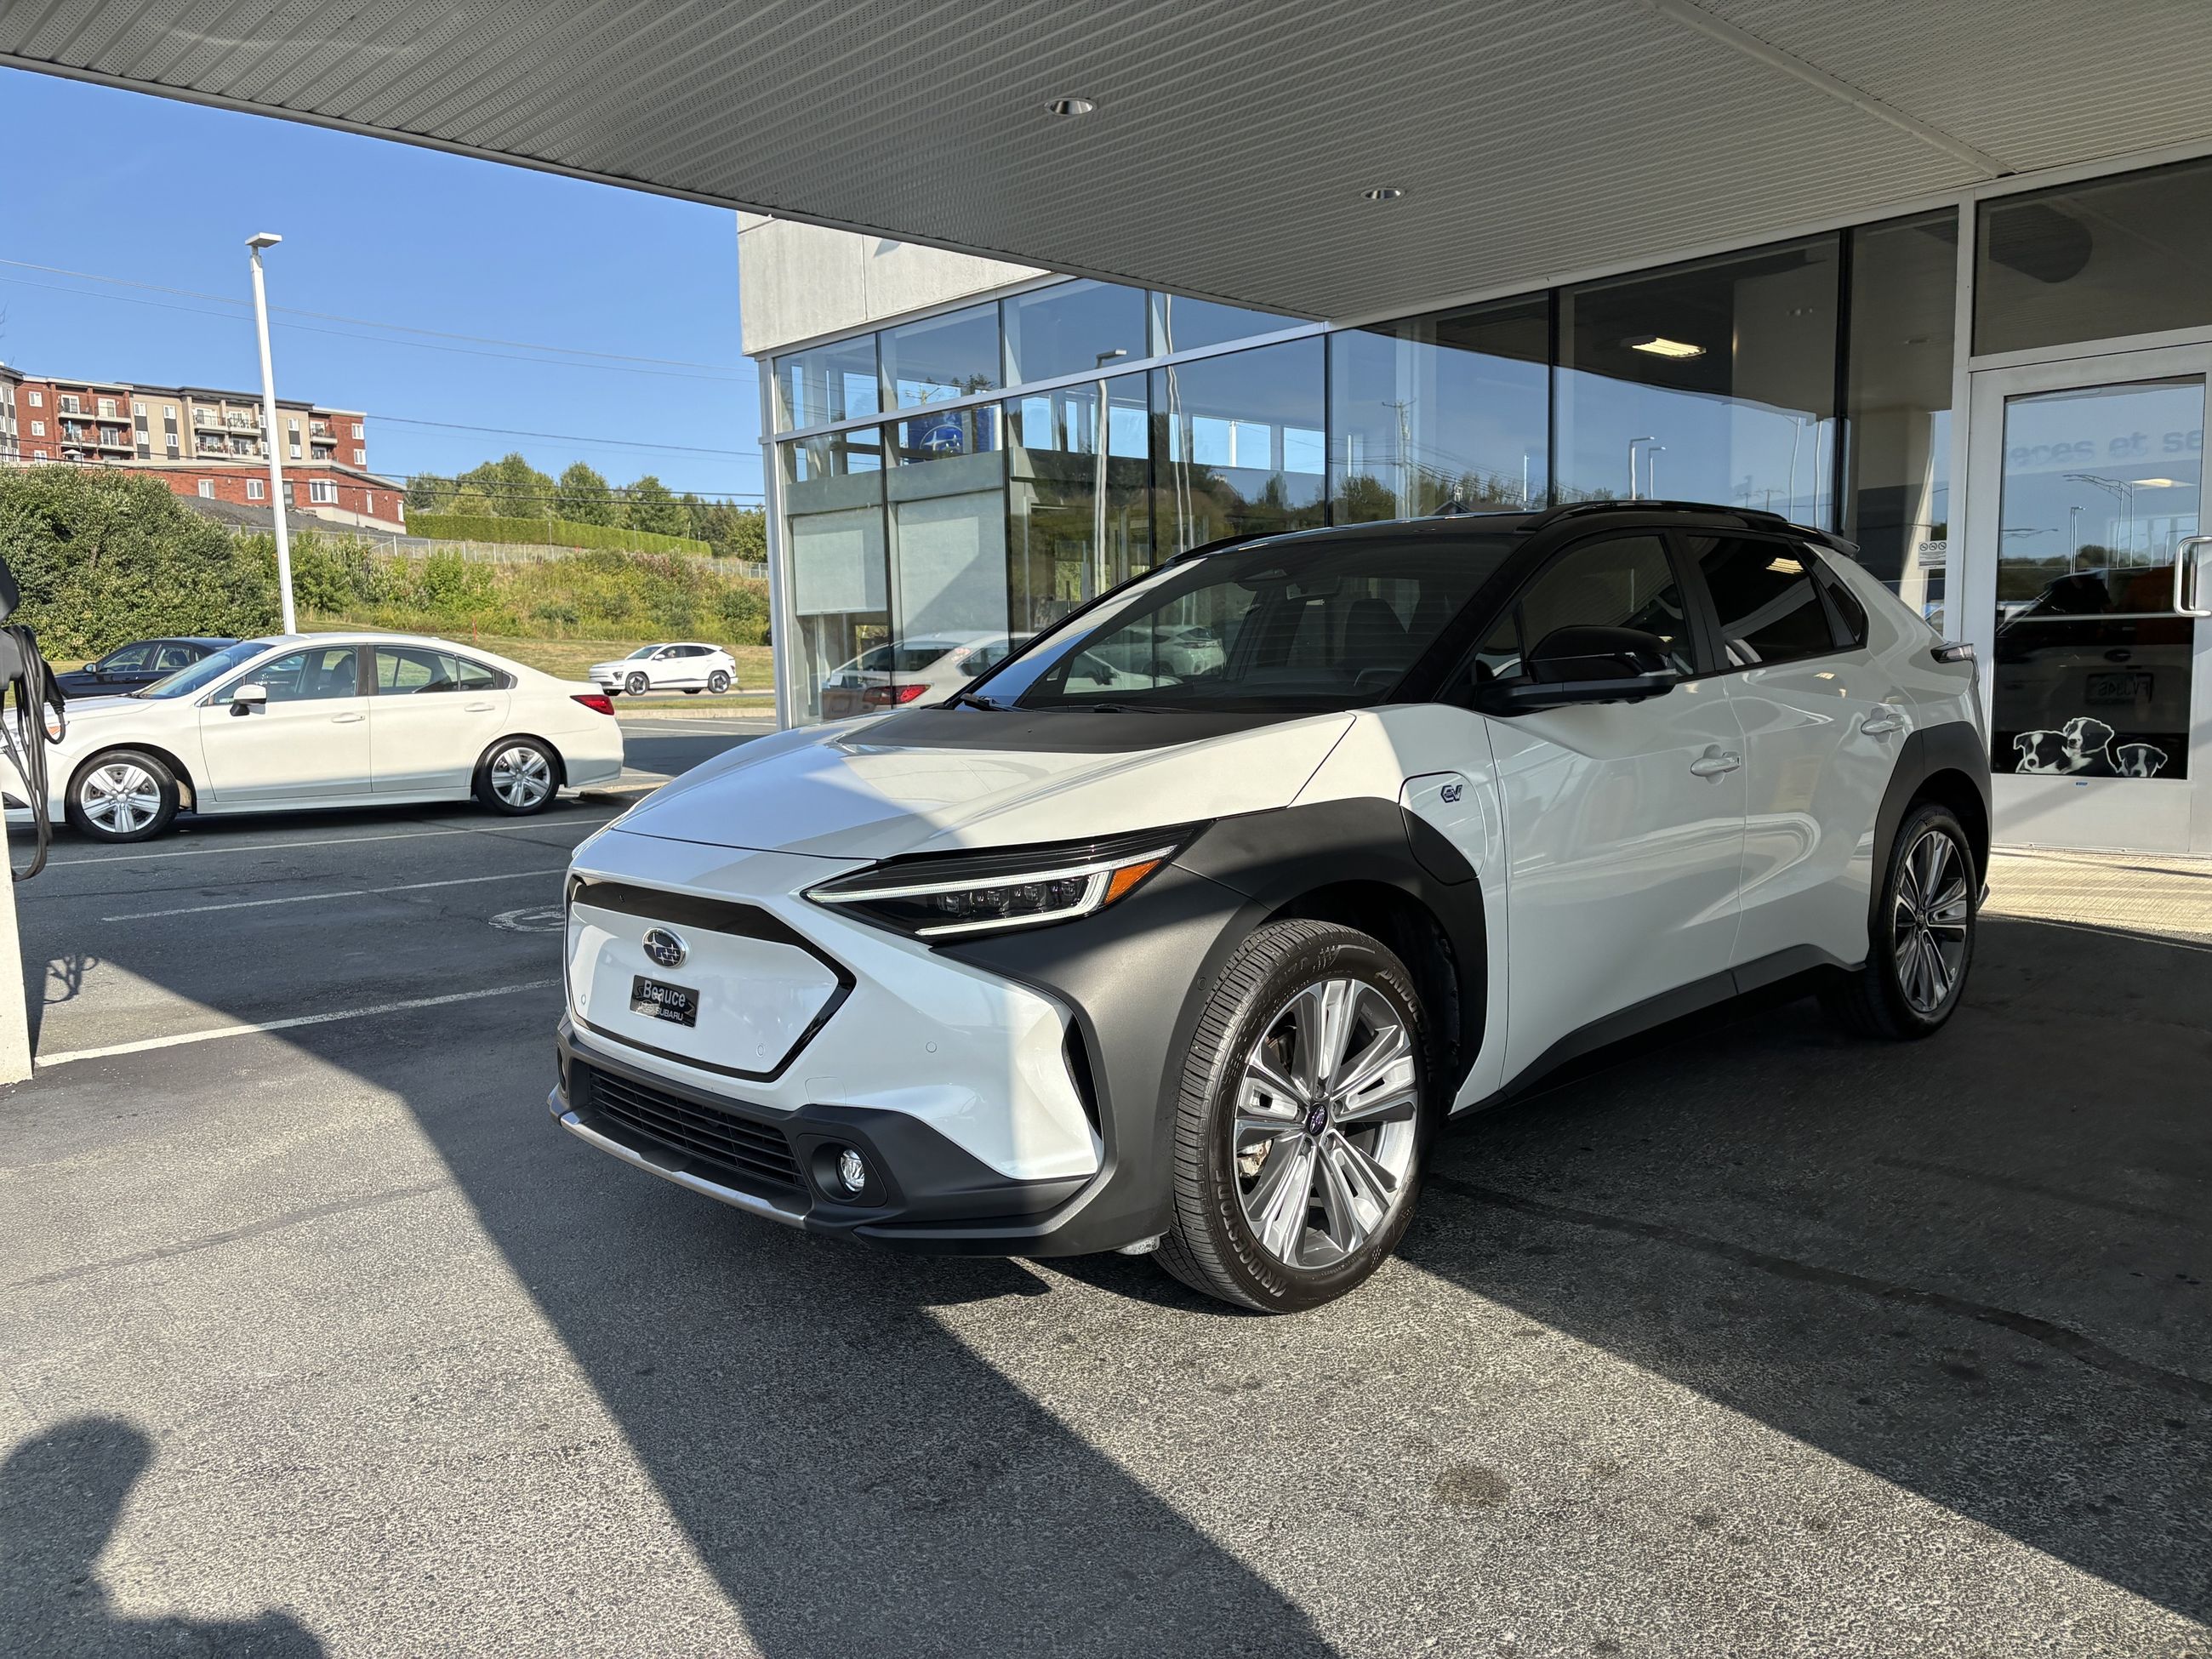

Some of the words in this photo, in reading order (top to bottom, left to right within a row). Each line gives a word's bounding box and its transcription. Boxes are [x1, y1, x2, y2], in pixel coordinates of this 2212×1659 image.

[2108, 431, 2149, 456] et
[643, 980, 686, 1006] Beauce
[656, 1007, 684, 1021] SUBARU
[1215, 1170, 1287, 1298] BRIDGESTONE
